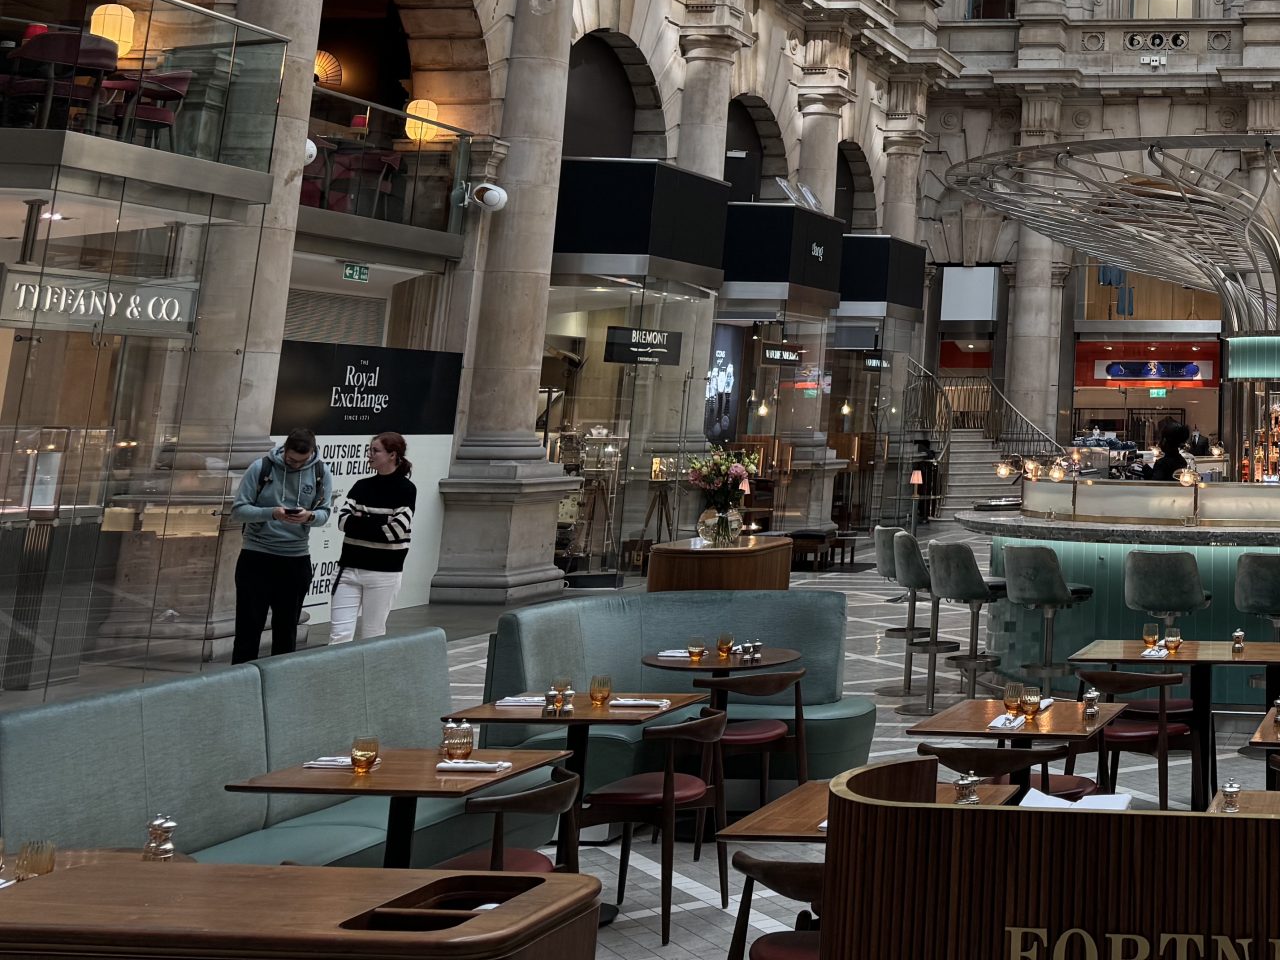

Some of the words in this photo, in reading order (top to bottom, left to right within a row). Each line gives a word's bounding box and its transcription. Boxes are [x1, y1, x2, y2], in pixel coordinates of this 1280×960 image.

[14, 282, 123, 317] TIFFANY
[126, 294, 142, 319] &
[147, 295, 183, 322] CO.
[631, 330, 668, 345] BREMONT
[344, 365, 380, 391] Royal
[330, 386, 389, 414] Exchange
[322, 444, 361, 459] OUTSIDE
